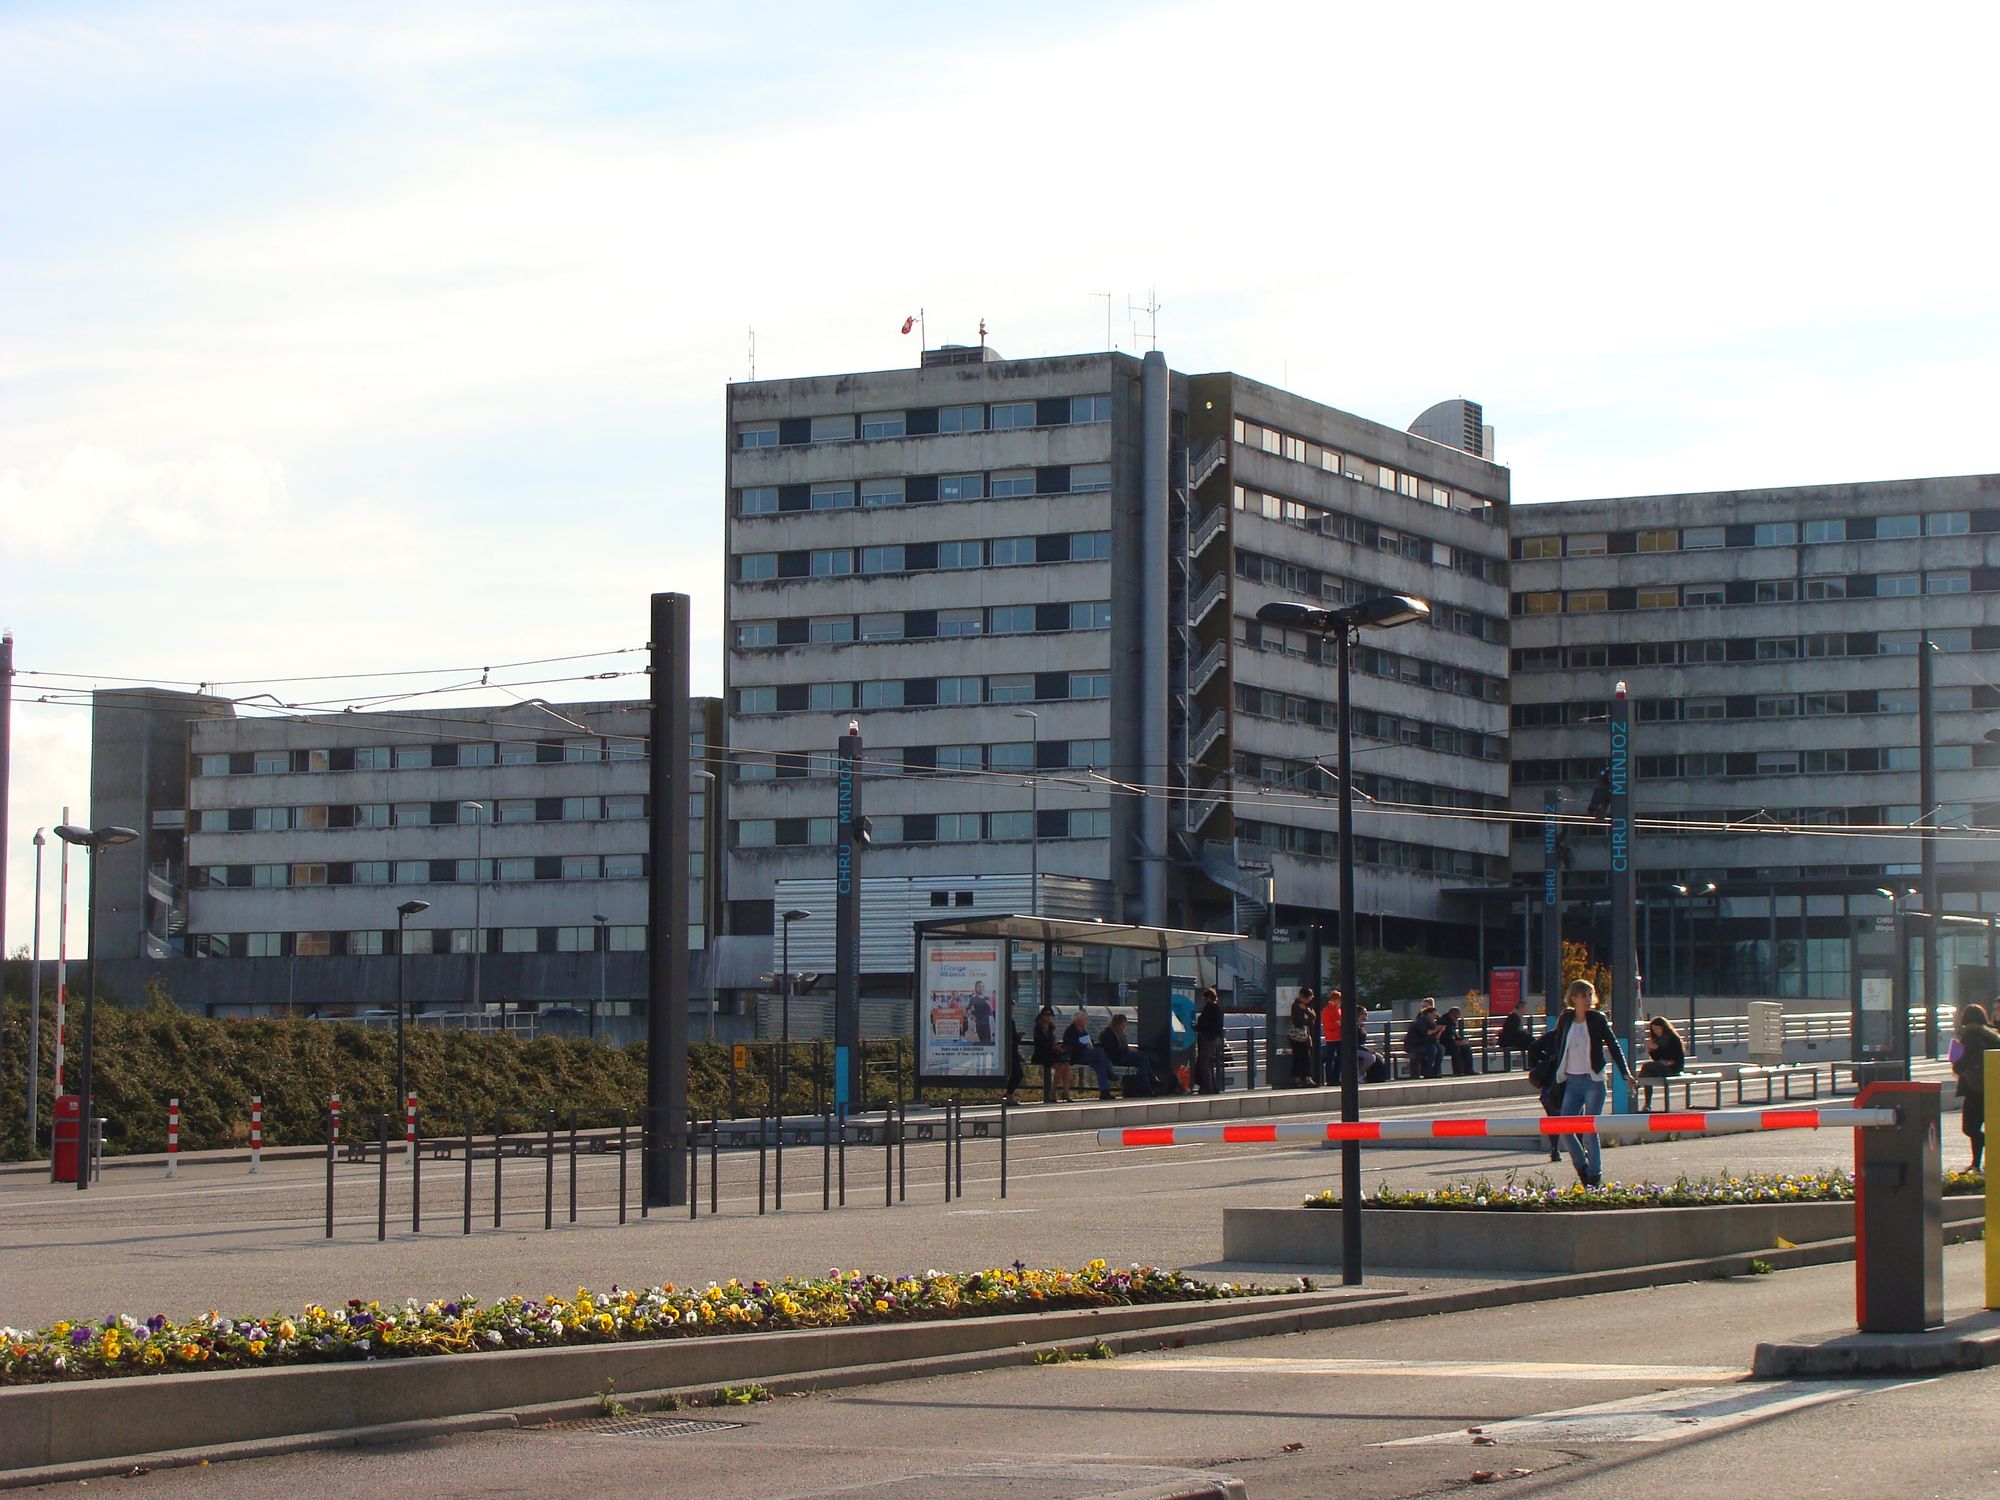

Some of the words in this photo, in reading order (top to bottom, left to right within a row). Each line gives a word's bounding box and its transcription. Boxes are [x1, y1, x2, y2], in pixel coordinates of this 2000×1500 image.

[1611, 721, 1627, 795] MINJOZ
[840, 755, 853, 824] MINJOZ
[838, 845, 852, 894] CHRU
[1612, 818, 1628, 872] CHRU
[1545, 868, 1556, 906] CHRU
